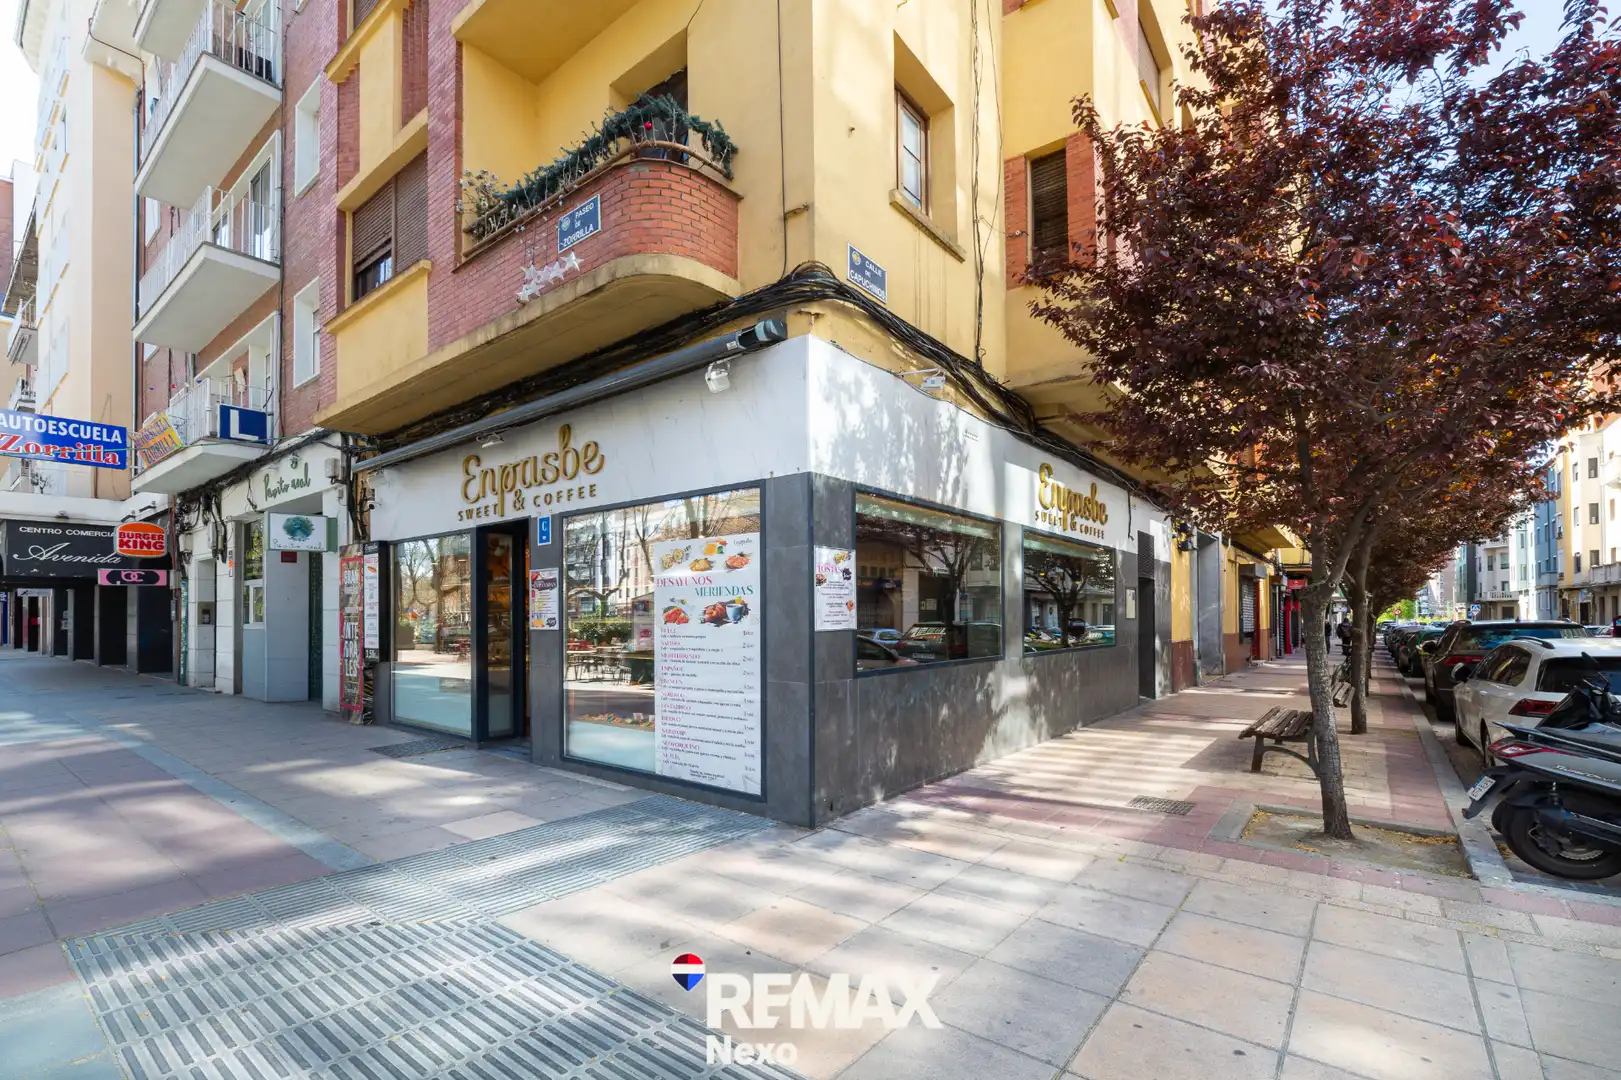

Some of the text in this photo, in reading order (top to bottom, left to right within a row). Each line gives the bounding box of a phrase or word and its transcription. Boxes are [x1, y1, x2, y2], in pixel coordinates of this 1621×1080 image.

[575, 202, 595, 219] PASEO
[574, 219, 581, 229] DE
[562, 223, 594, 248] ZORRILLA
[864, 269, 871, 278] DE
[865, 260, 882, 277] CALLE
[850, 269, 886, 300] CAPUCHINOS
[0, 412, 122, 444] AUTOESCUELA
[230, 409, 259, 441] L
[0, 432, 121, 466] Zorrilla
[461, 423, 605, 517] Enpasbe
[457, 483, 597, 521] SWEET & COFFEE
[1038, 462, 1109, 531] Enpasbe
[19, 526, 114, 538] CENTRO COMERCIA
[118, 531, 165, 541] BURGER
[1035, 510, 1105, 540] SWEET & COFFEE
[12, 542, 122, 564] Avenida
[118, 538, 165, 551] KING
[656, 575, 713, 588] DESAYUNOS
[694, 584, 754, 597] MERIENDAS
